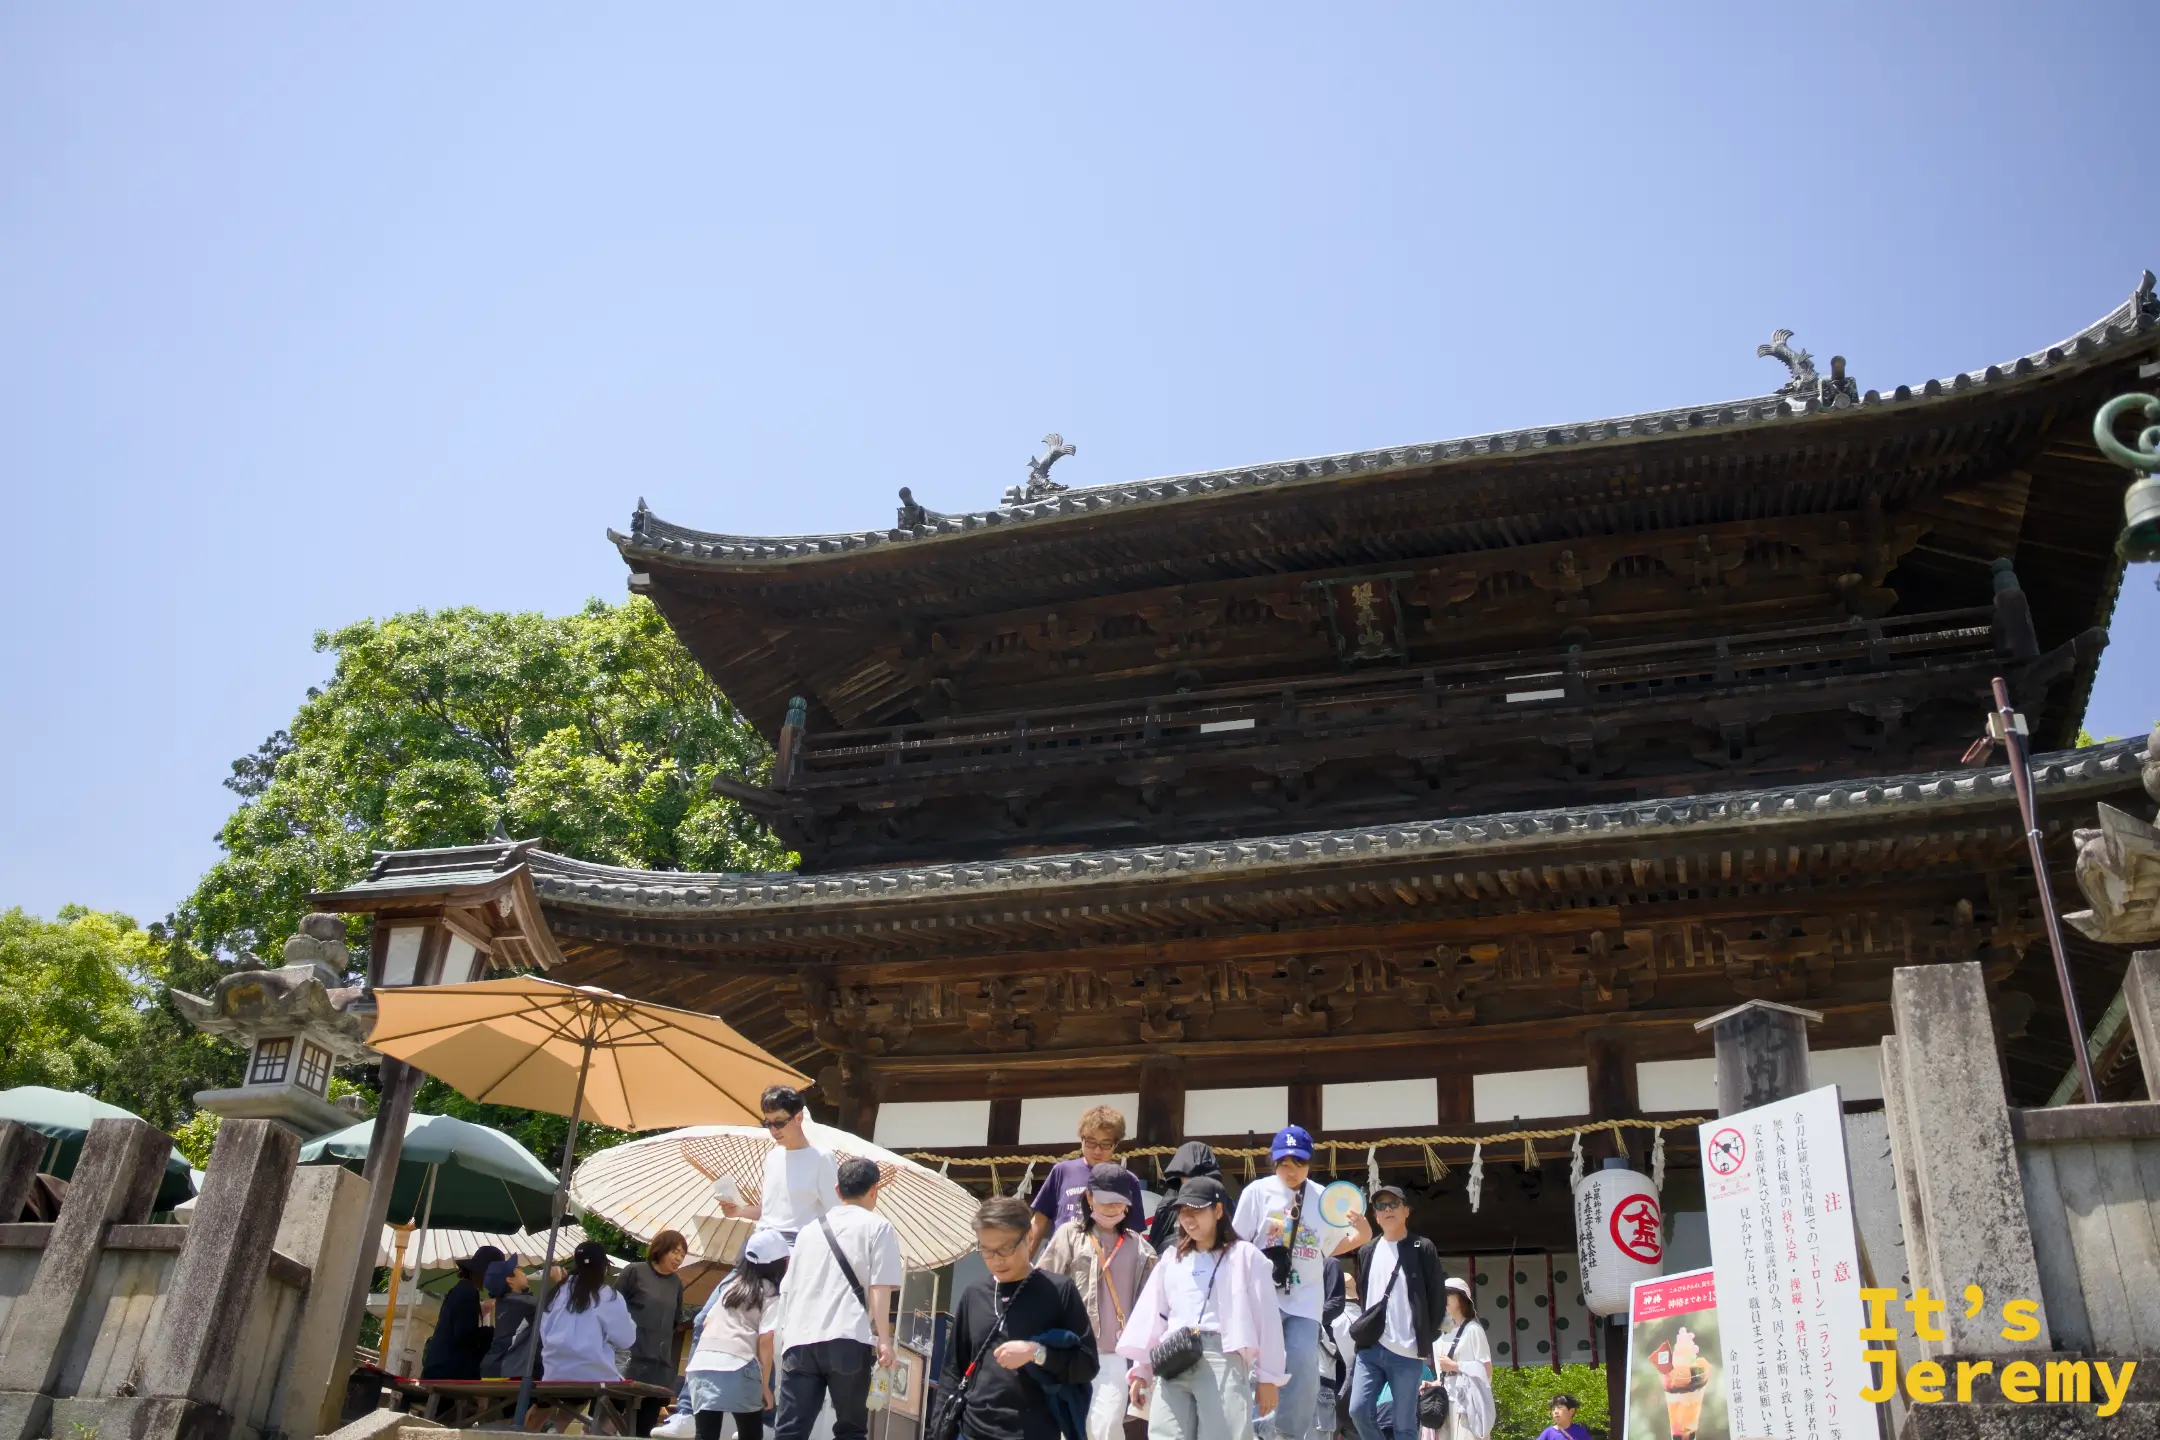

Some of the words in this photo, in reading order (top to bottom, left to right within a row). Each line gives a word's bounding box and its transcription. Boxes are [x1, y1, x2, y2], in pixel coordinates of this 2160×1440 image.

[1286, 1134, 1297, 1146] LA
[1621, 1203, 1660, 1254] 金
[1730, 1350, 1747, 1440] 金刀比羅宮社
